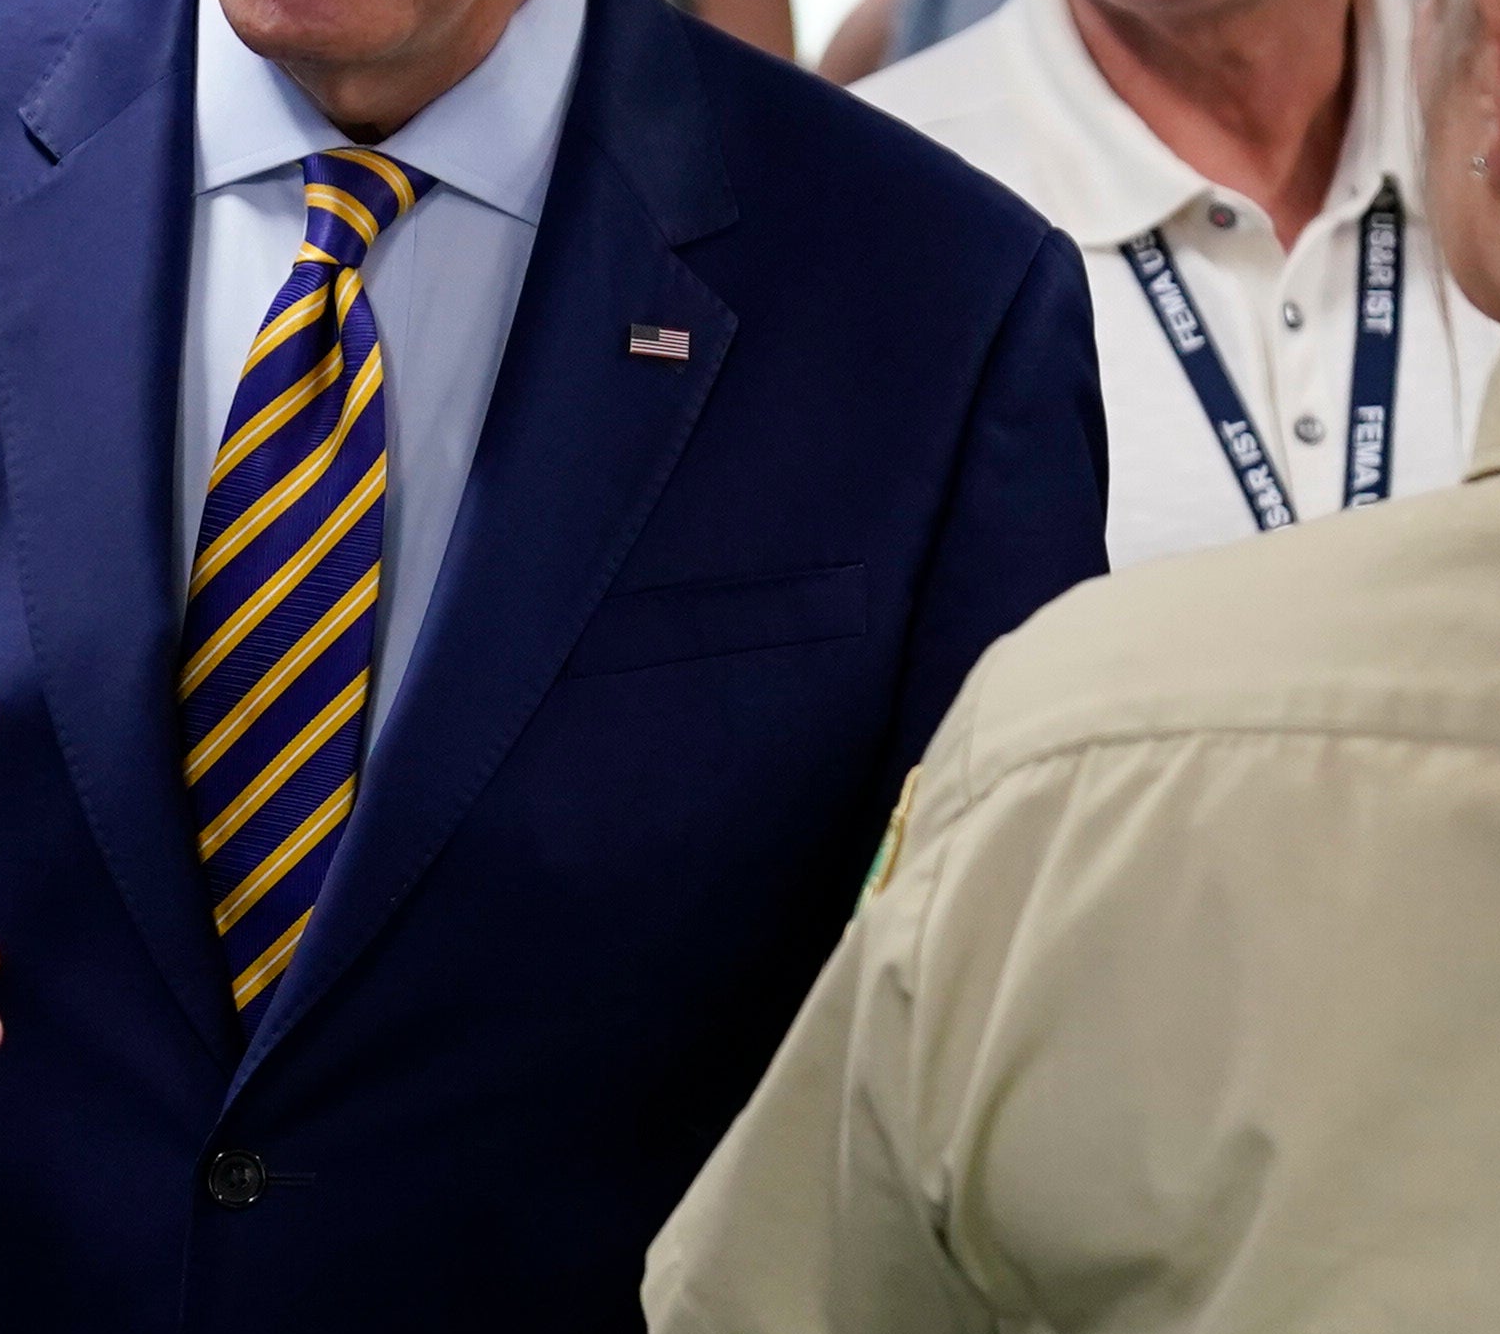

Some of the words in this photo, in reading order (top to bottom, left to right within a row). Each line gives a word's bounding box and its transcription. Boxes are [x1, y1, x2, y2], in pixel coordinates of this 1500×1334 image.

[1152, 269, 1205, 354] FEMA
[1365, 289, 1394, 335] IST
[1218, 418, 1262, 463] IST
[1352, 405, 1385, 491] FEMA
[1246, 463, 1292, 529] S&R
